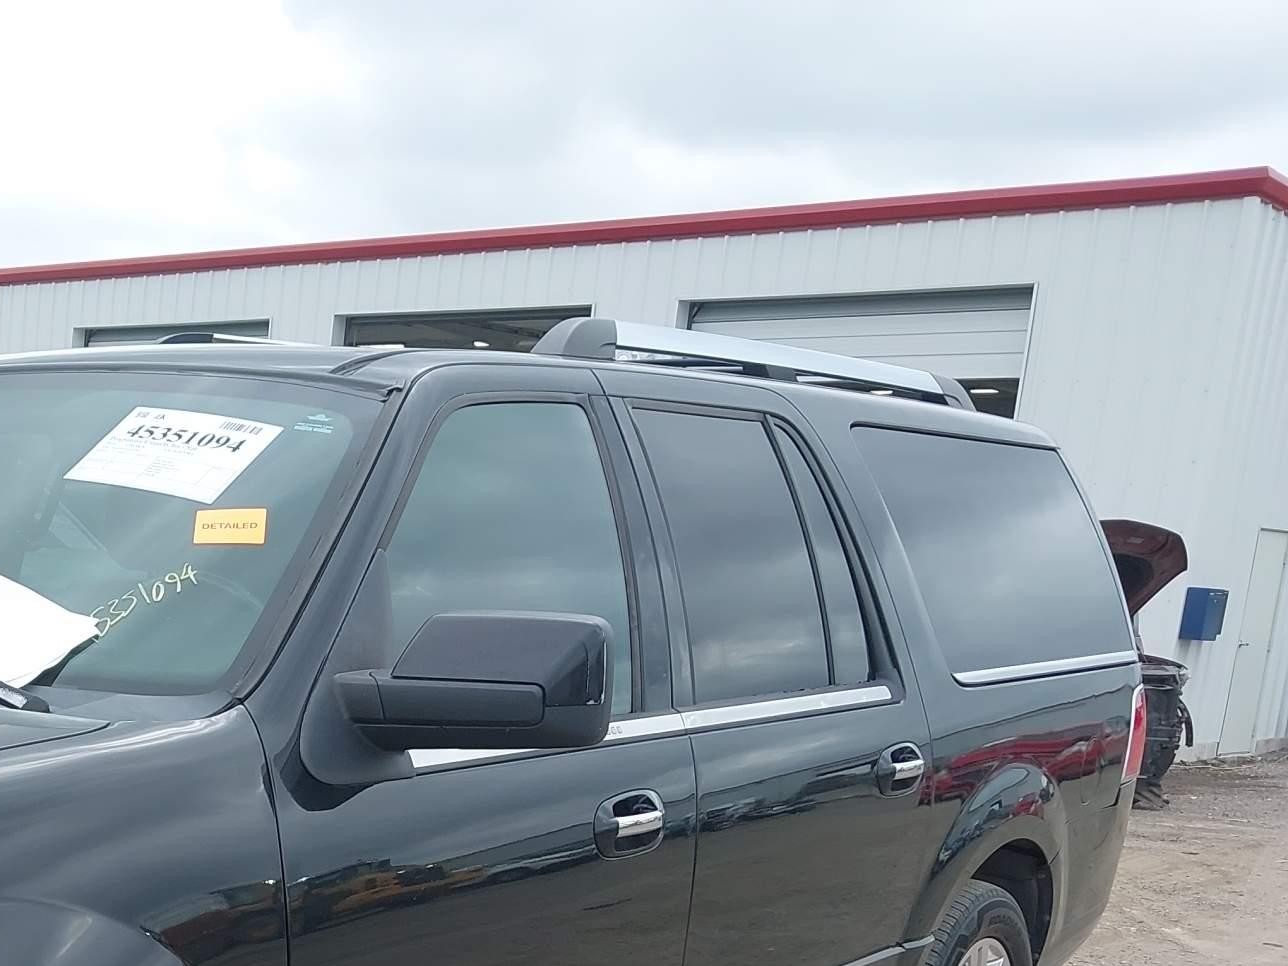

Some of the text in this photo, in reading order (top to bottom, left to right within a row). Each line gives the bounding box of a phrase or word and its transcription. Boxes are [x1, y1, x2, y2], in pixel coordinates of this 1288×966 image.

[126, 423, 247, 453] 45351094
[201, 521, 259, 531] DETAILED
[89, 561, 199, 642] 5351094
